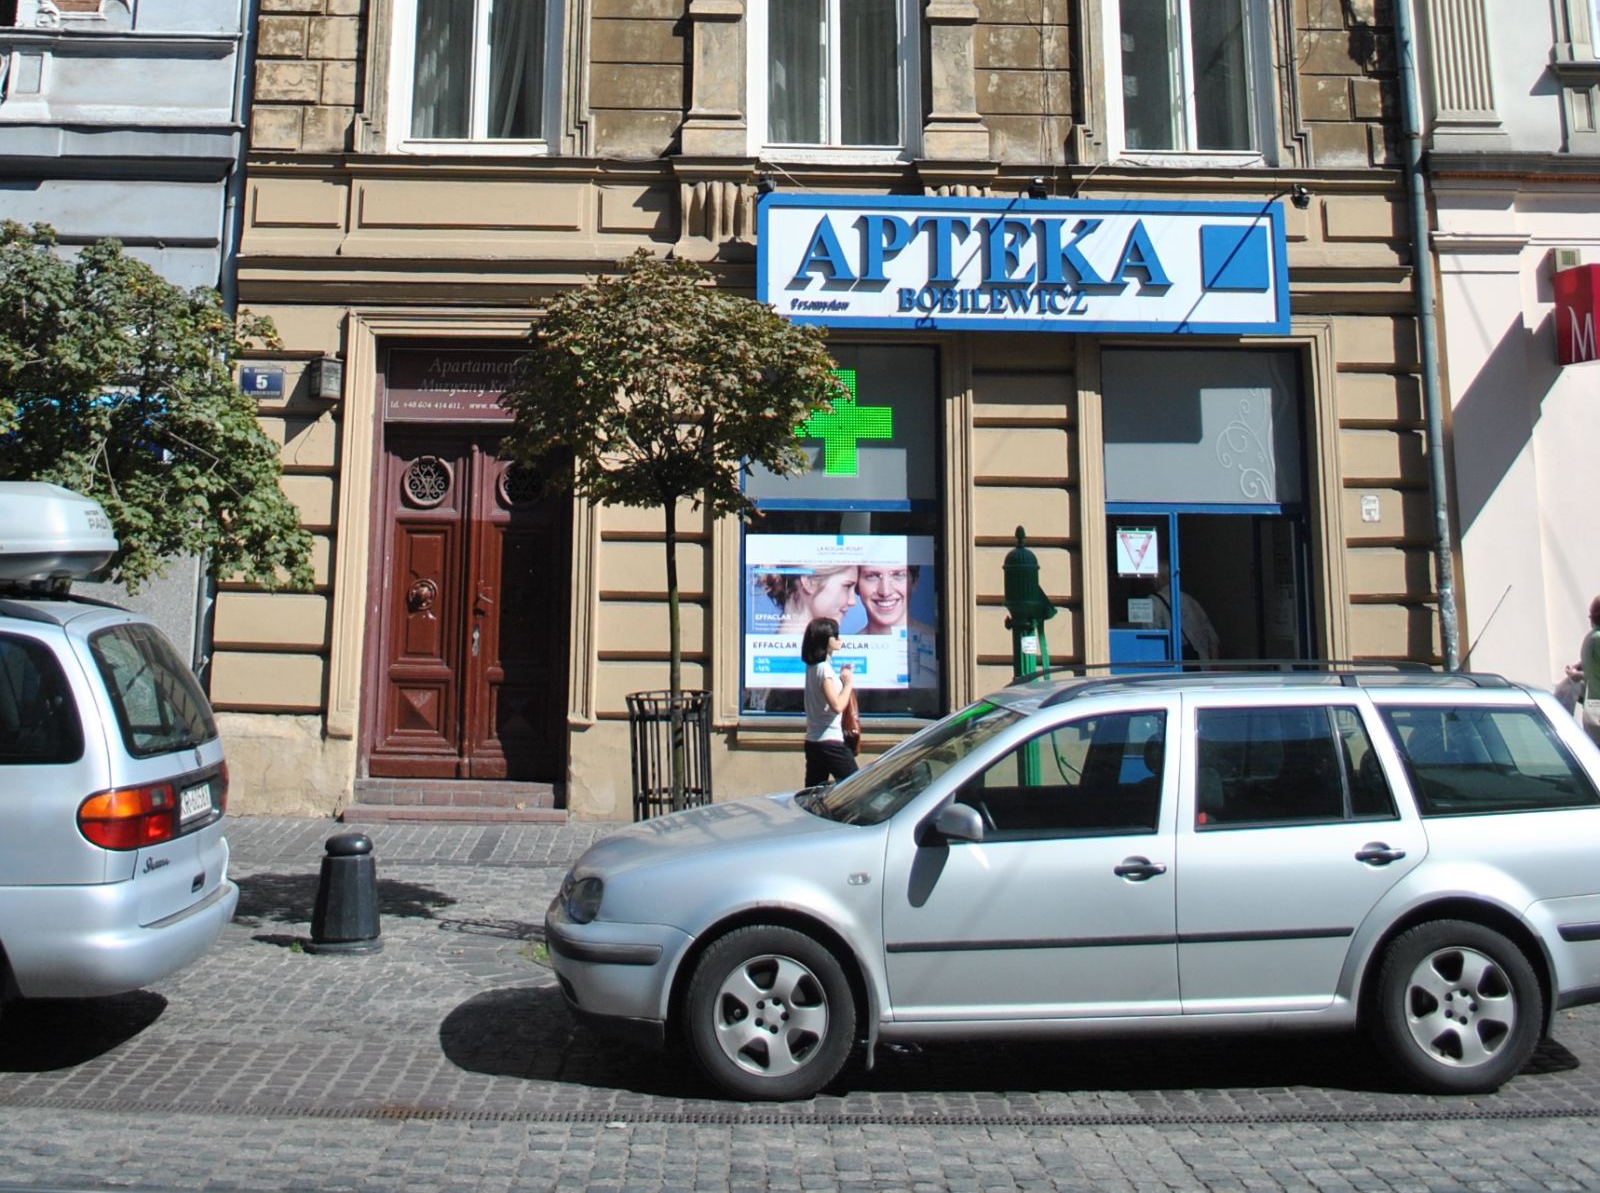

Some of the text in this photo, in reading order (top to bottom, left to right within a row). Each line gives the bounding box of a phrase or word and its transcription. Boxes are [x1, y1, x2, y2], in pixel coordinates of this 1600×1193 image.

[797, 212, 1173, 286] APTEKA
[898, 287, 1088, 315] BOBILEWICZ
[256, 374, 268, 390] 5
[753, 641, 798, 649] EFFACLAR
